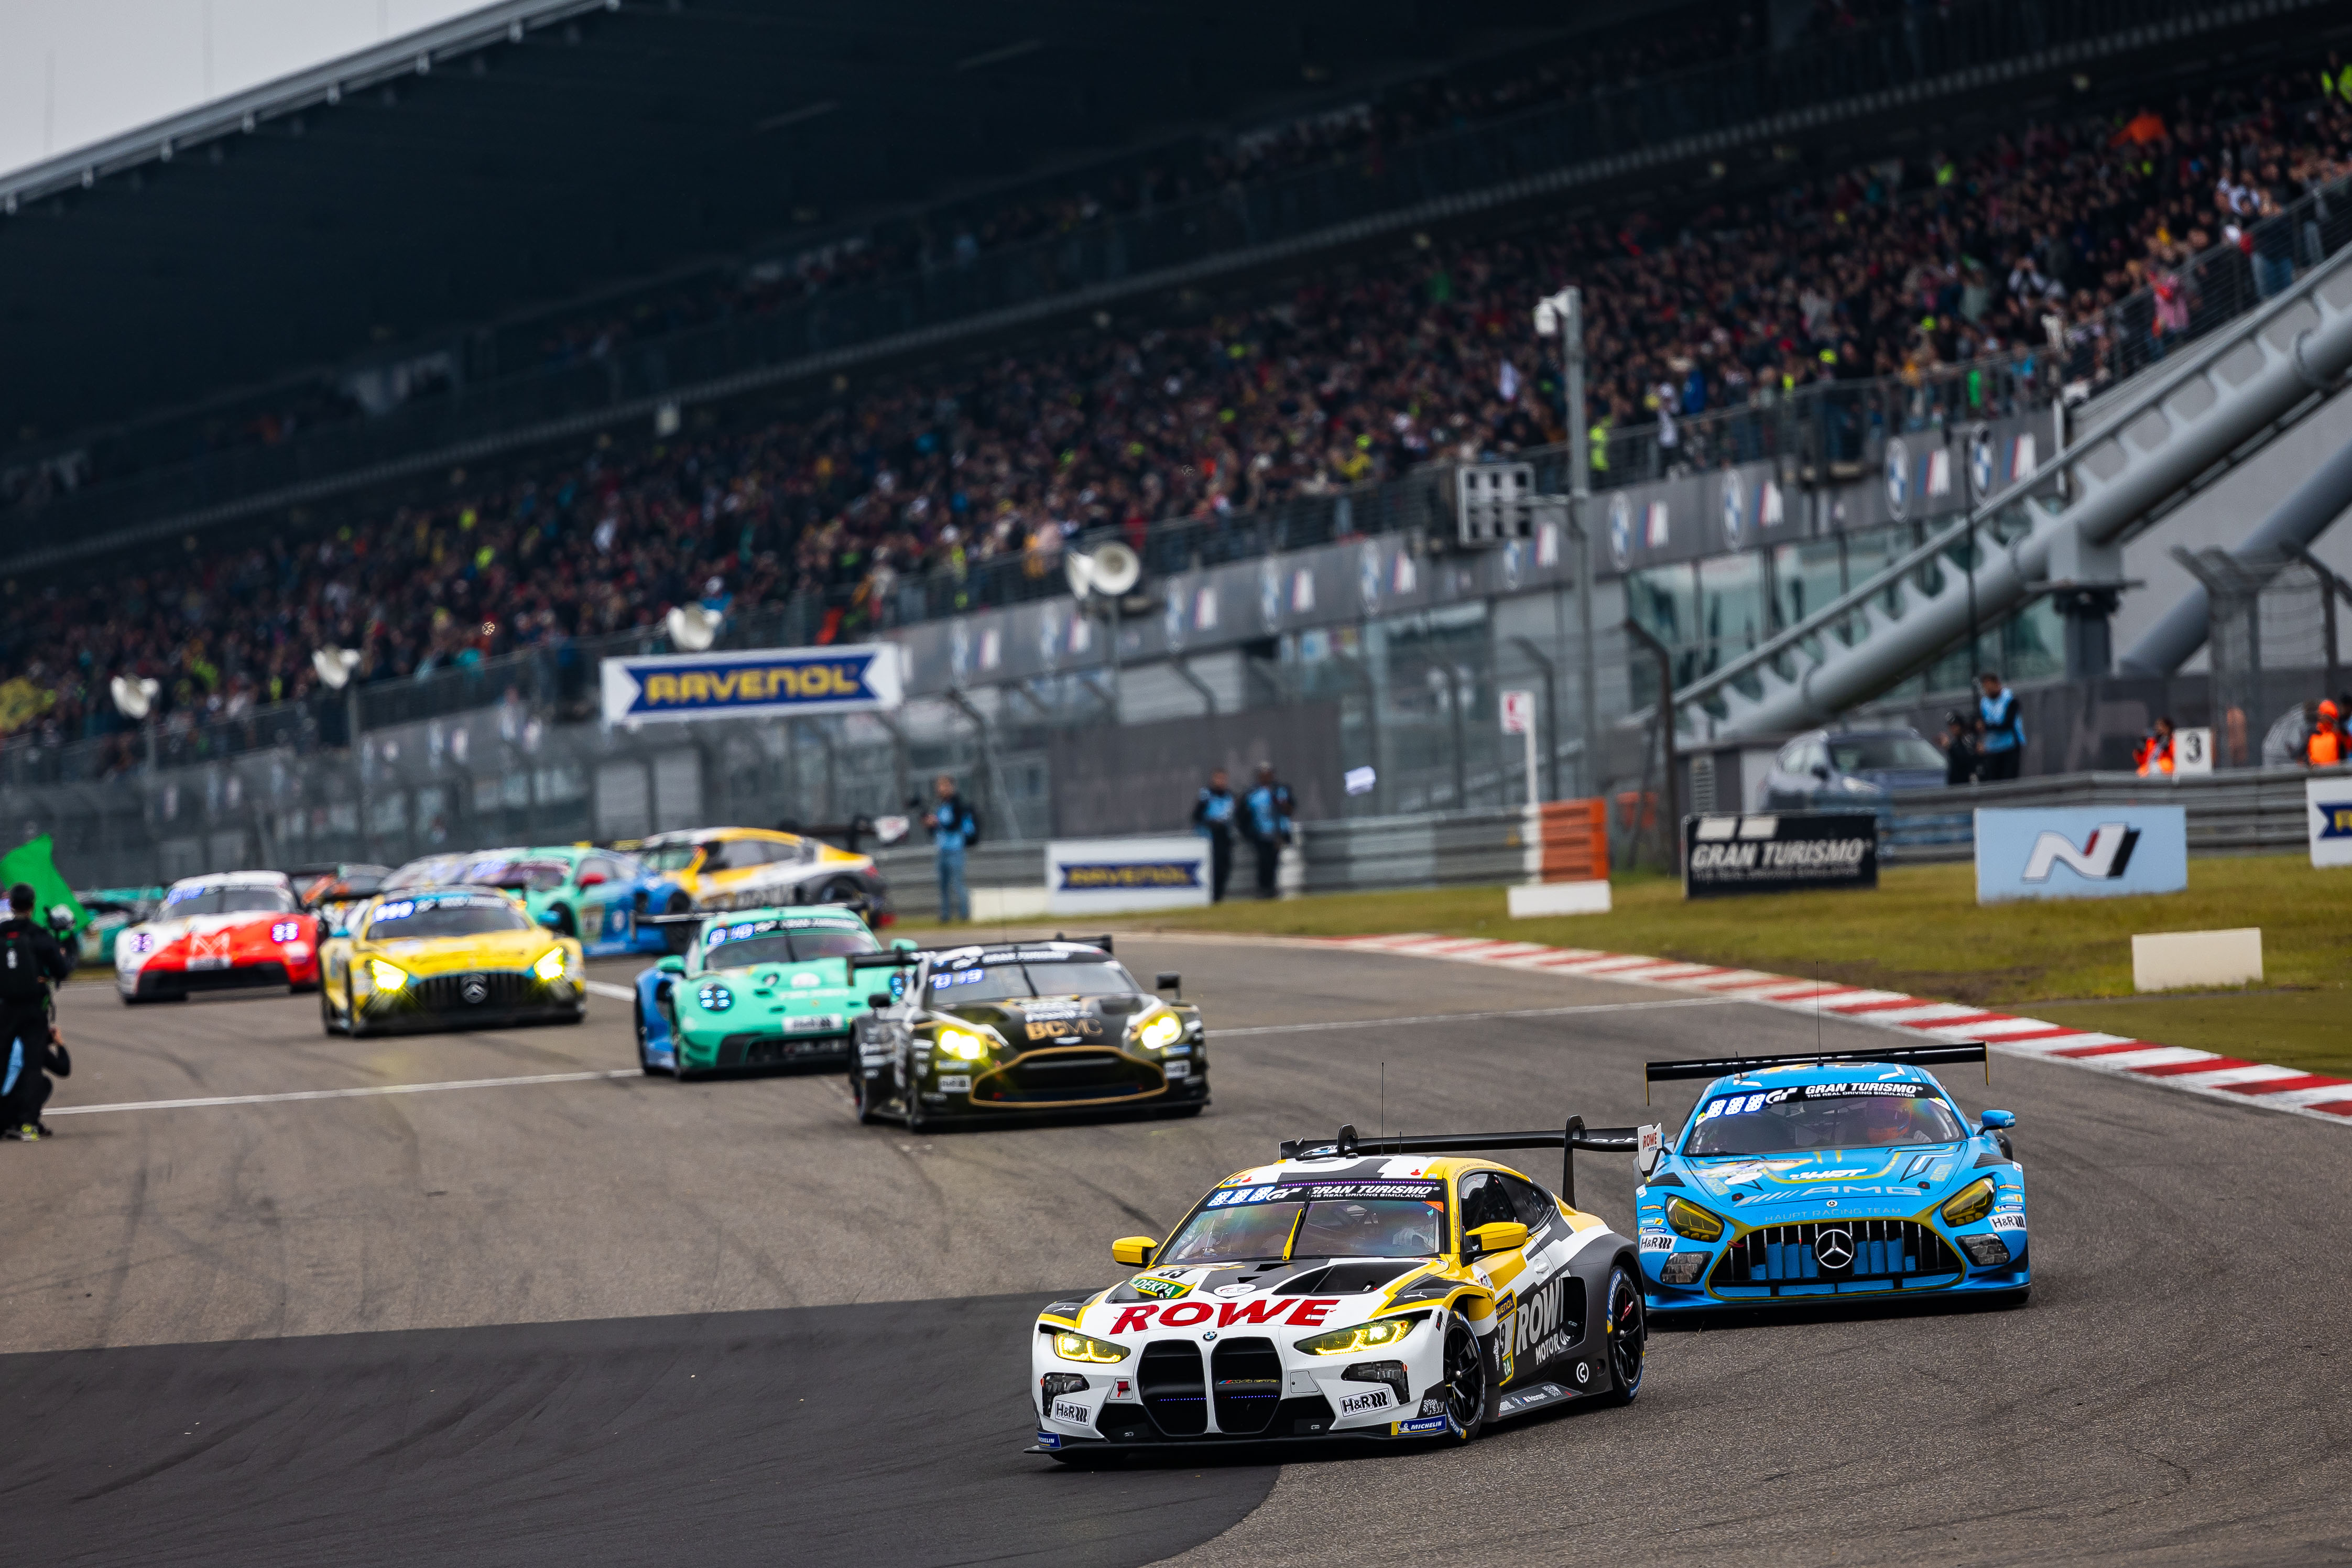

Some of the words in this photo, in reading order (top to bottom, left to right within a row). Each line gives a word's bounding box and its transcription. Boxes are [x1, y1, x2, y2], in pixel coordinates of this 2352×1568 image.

[645, 665, 860, 705] RAVENOL
[2186, 733, 2201, 764] 3
[1691, 842, 1758, 870] GRAN
[1760, 838, 1865, 867] TURISMO
[1805, 1083, 1847, 1094] GRAN
[1852, 1082, 1917, 1094] TURISMO
[1643, 1132, 1657, 1150] ROWE
[1357, 1185, 1433, 1194] TURISMO
[1800, 1185, 1922, 1197] AMG
[1765, 1211, 1807, 1222] HAUPT
[1812, 1208, 1861, 1217] RACING
[1608, 1272, 1621, 1312] MICHELIN
[1109, 1299, 1341, 1335] ROWE
[1496, 1300, 1513, 1317] AVENOL
[1536, 1333, 1561, 1366] MOTOR
[1410, 1421, 1442, 1430] MICHELIN
